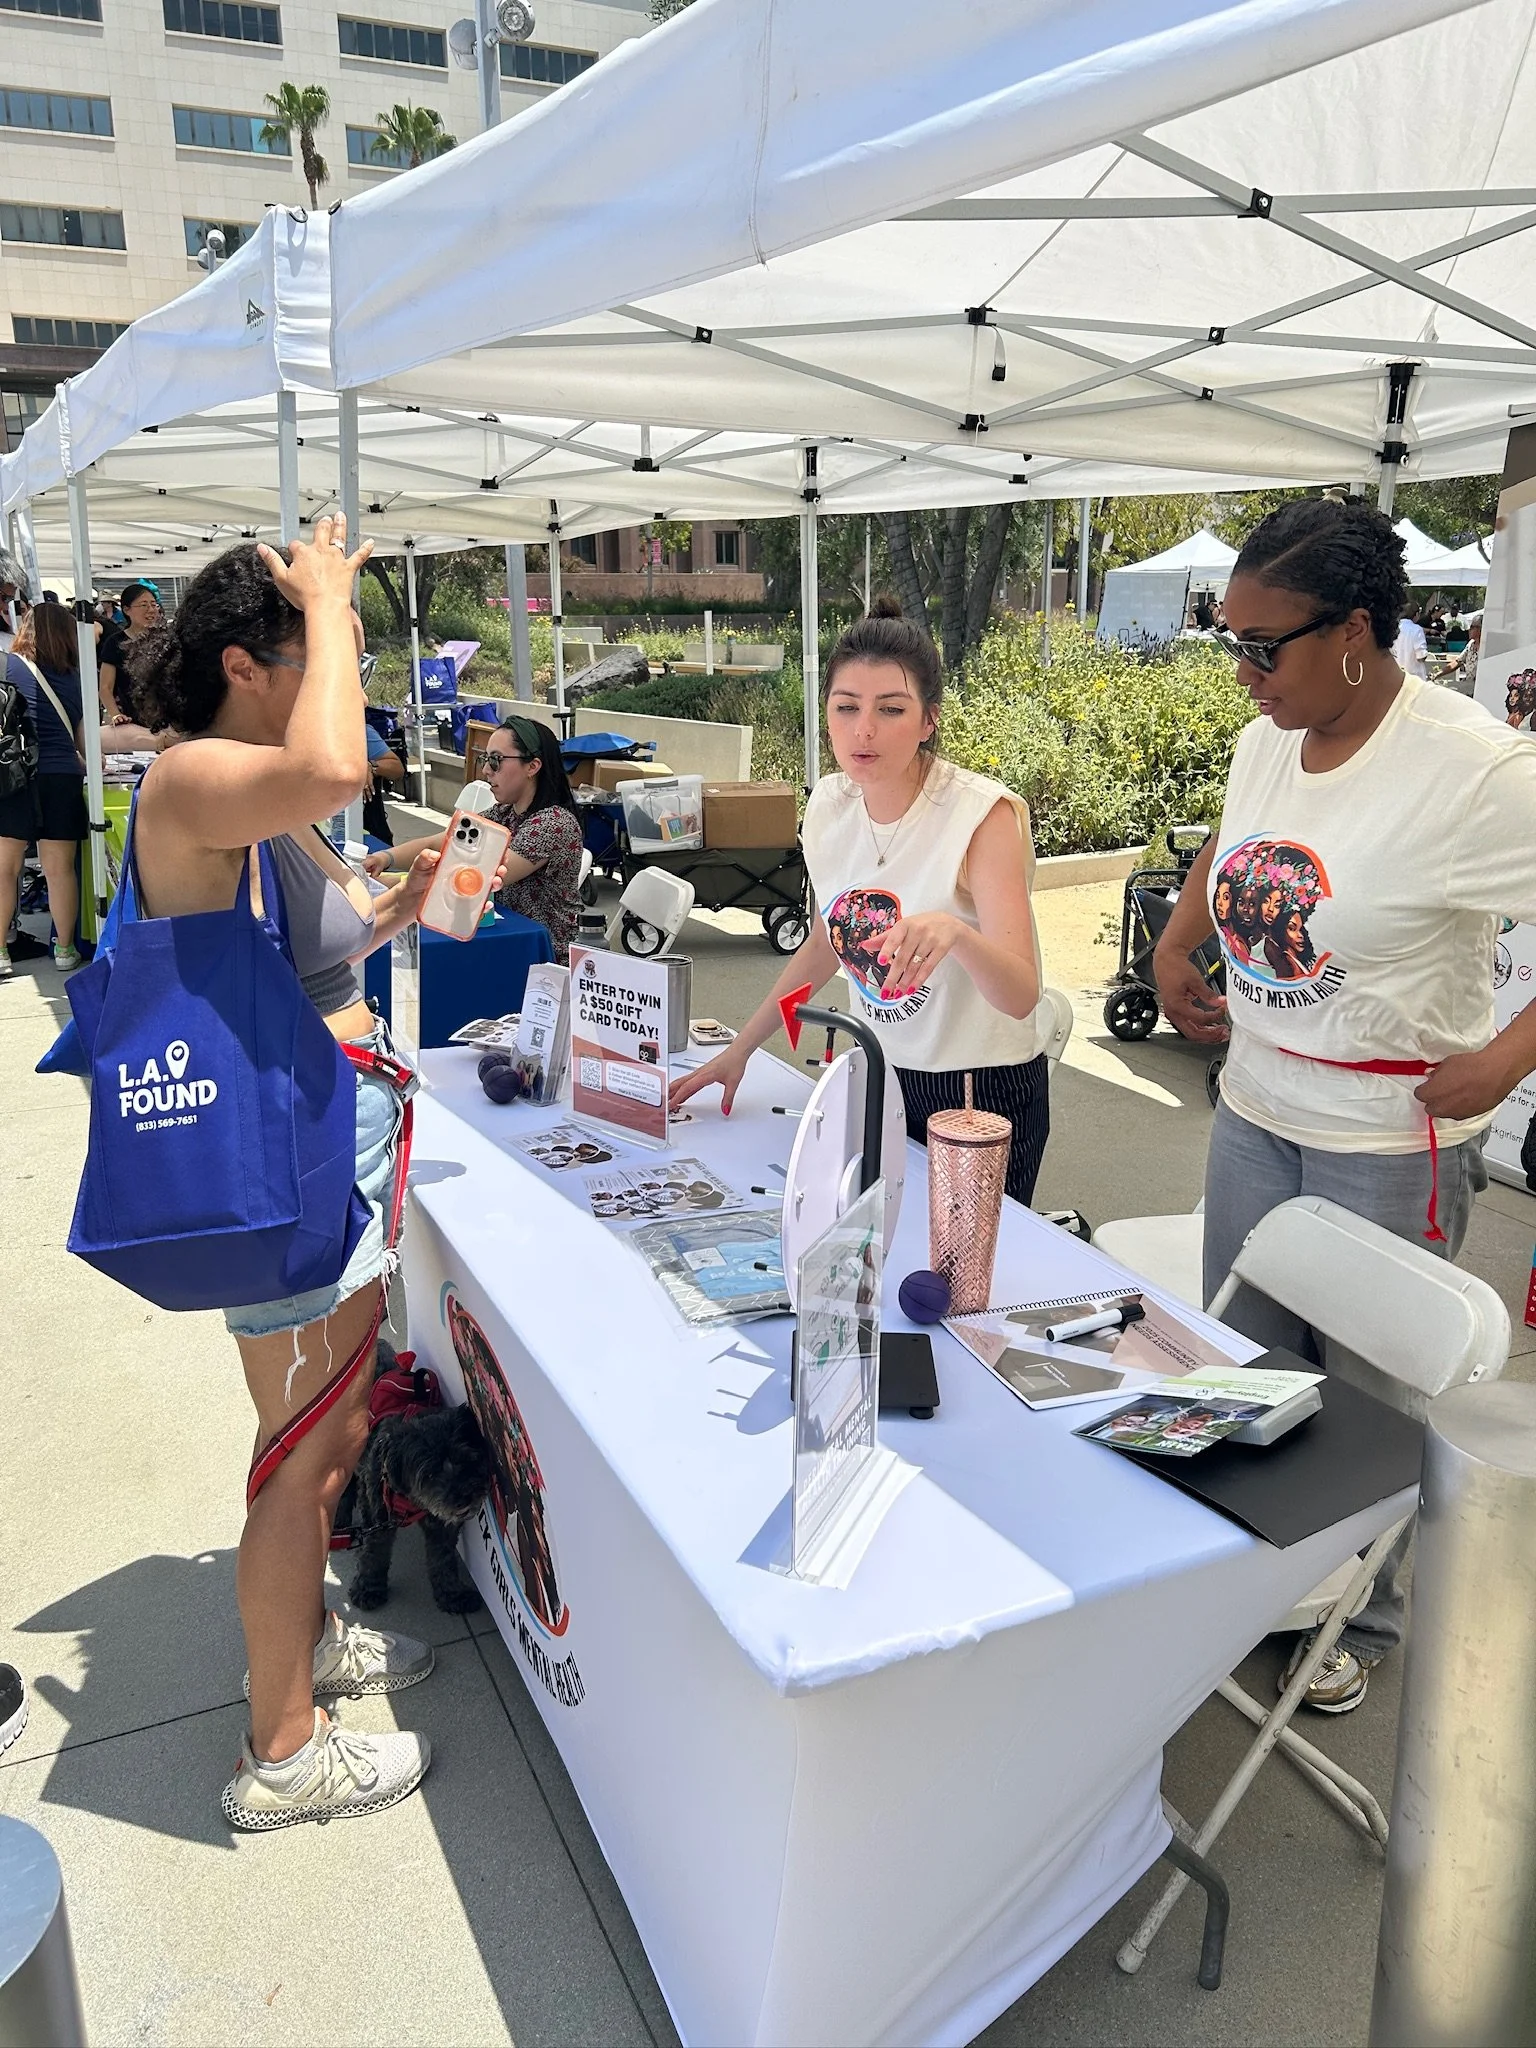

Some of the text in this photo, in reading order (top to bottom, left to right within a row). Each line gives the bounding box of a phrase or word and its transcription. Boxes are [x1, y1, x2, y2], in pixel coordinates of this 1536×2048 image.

[579, 978, 661, 1010] ENTER TO WIN
[579, 993, 642, 1020] A $50 GIFT
[873, 1006, 907, 1024] MENTAL
[900, 984, 932, 1018] HEALTH
[1233, 973, 1263, 1004] GIRLS
[1266, 988, 1319, 1009] MENTAL
[579, 1008, 611, 1027] CARD
[613, 1017, 659, 1041] TODAY!
[118, 1058, 170, 1089] L.A.
[118, 1079, 219, 1118] FOUND
[1518, 1096, 1530, 1107] for
[135, 1114, 198, 1133] (833) 569-7651
[1129, 1323, 1154, 1340] NEEDS
[1151, 1339, 1197, 1371] ASSESSMENT
[1157, 1336, 1200, 1366] COMMUNITY
[845, 1393, 873, 1439] MENTAL
[489, 1546, 586, 1707] GIRLS MENTAL HEALTH
